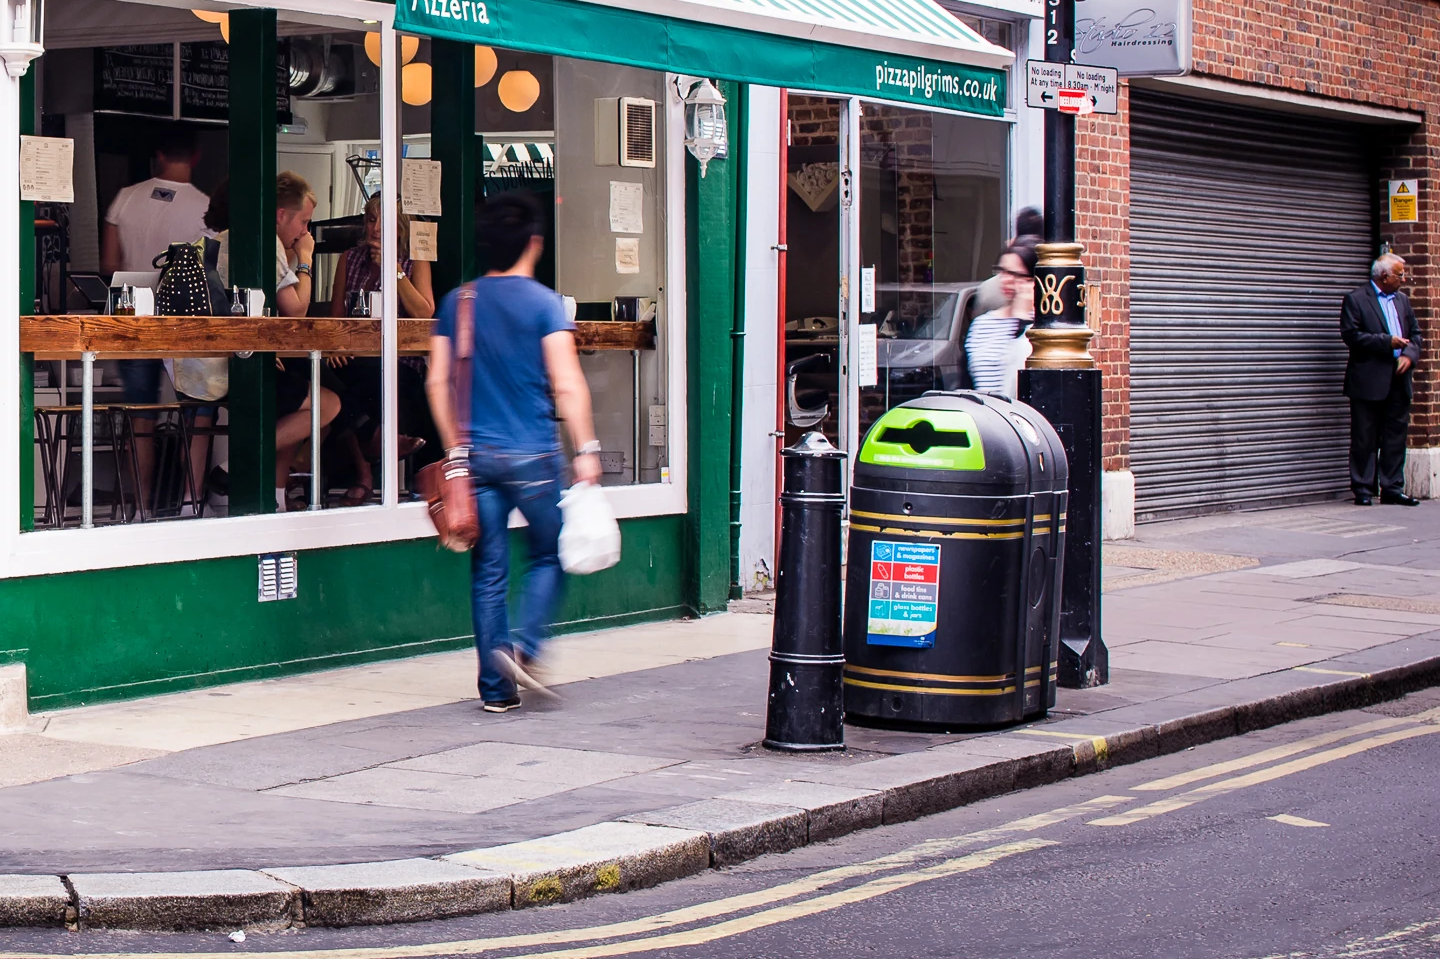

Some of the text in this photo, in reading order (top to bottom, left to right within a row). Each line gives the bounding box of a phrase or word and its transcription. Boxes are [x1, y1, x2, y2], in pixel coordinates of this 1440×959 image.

[1111, 39, 1173, 47] Hairdressing
[1031, 67, 1062, 79] No loading
[1076, 71, 1106, 83] No loading
[875, 61, 998, 102] pizzapilgrims.co.uk
[1031, 77, 1063, 89] At any time
[900, 585, 915, 593] food
[901, 592, 917, 600] drink
[910, 604, 933, 612] bottles
